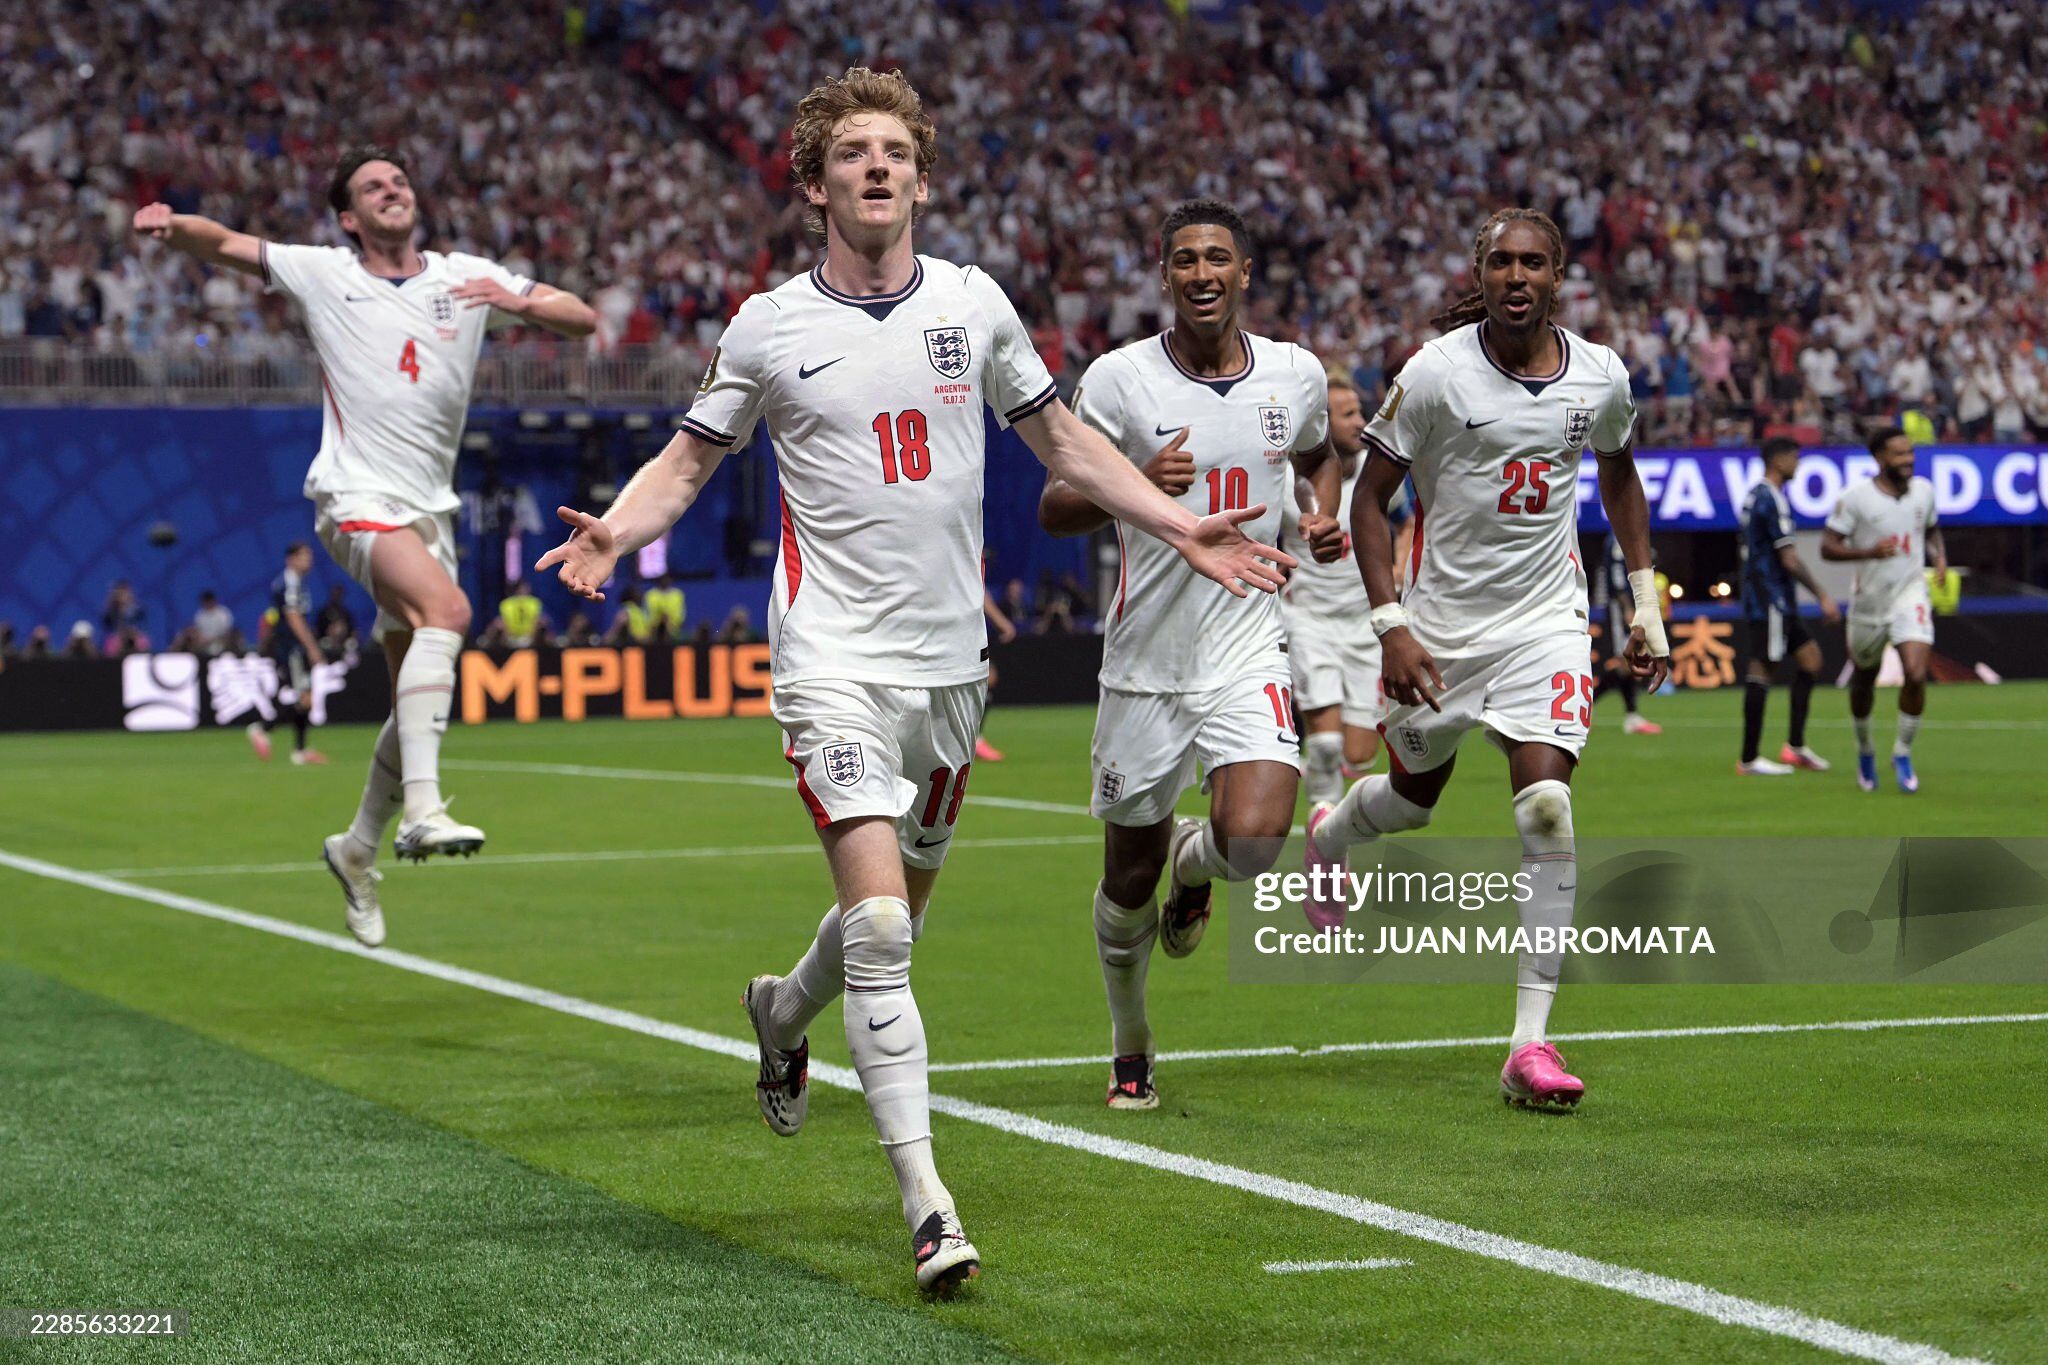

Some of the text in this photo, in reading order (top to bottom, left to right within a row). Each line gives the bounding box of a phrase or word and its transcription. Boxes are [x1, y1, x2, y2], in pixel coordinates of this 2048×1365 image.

[399, 338, 420, 383] 4
[934, 384, 971, 394] ARGENTINA
[872, 408, 931, 484] 18
[1206, 467, 1248, 515] 10
[1498, 461, 1551, 514] 25
[461, 644, 773, 725] M-PLUS
[1551, 671, 1593, 728] 25
[921, 762, 971, 828] 18
